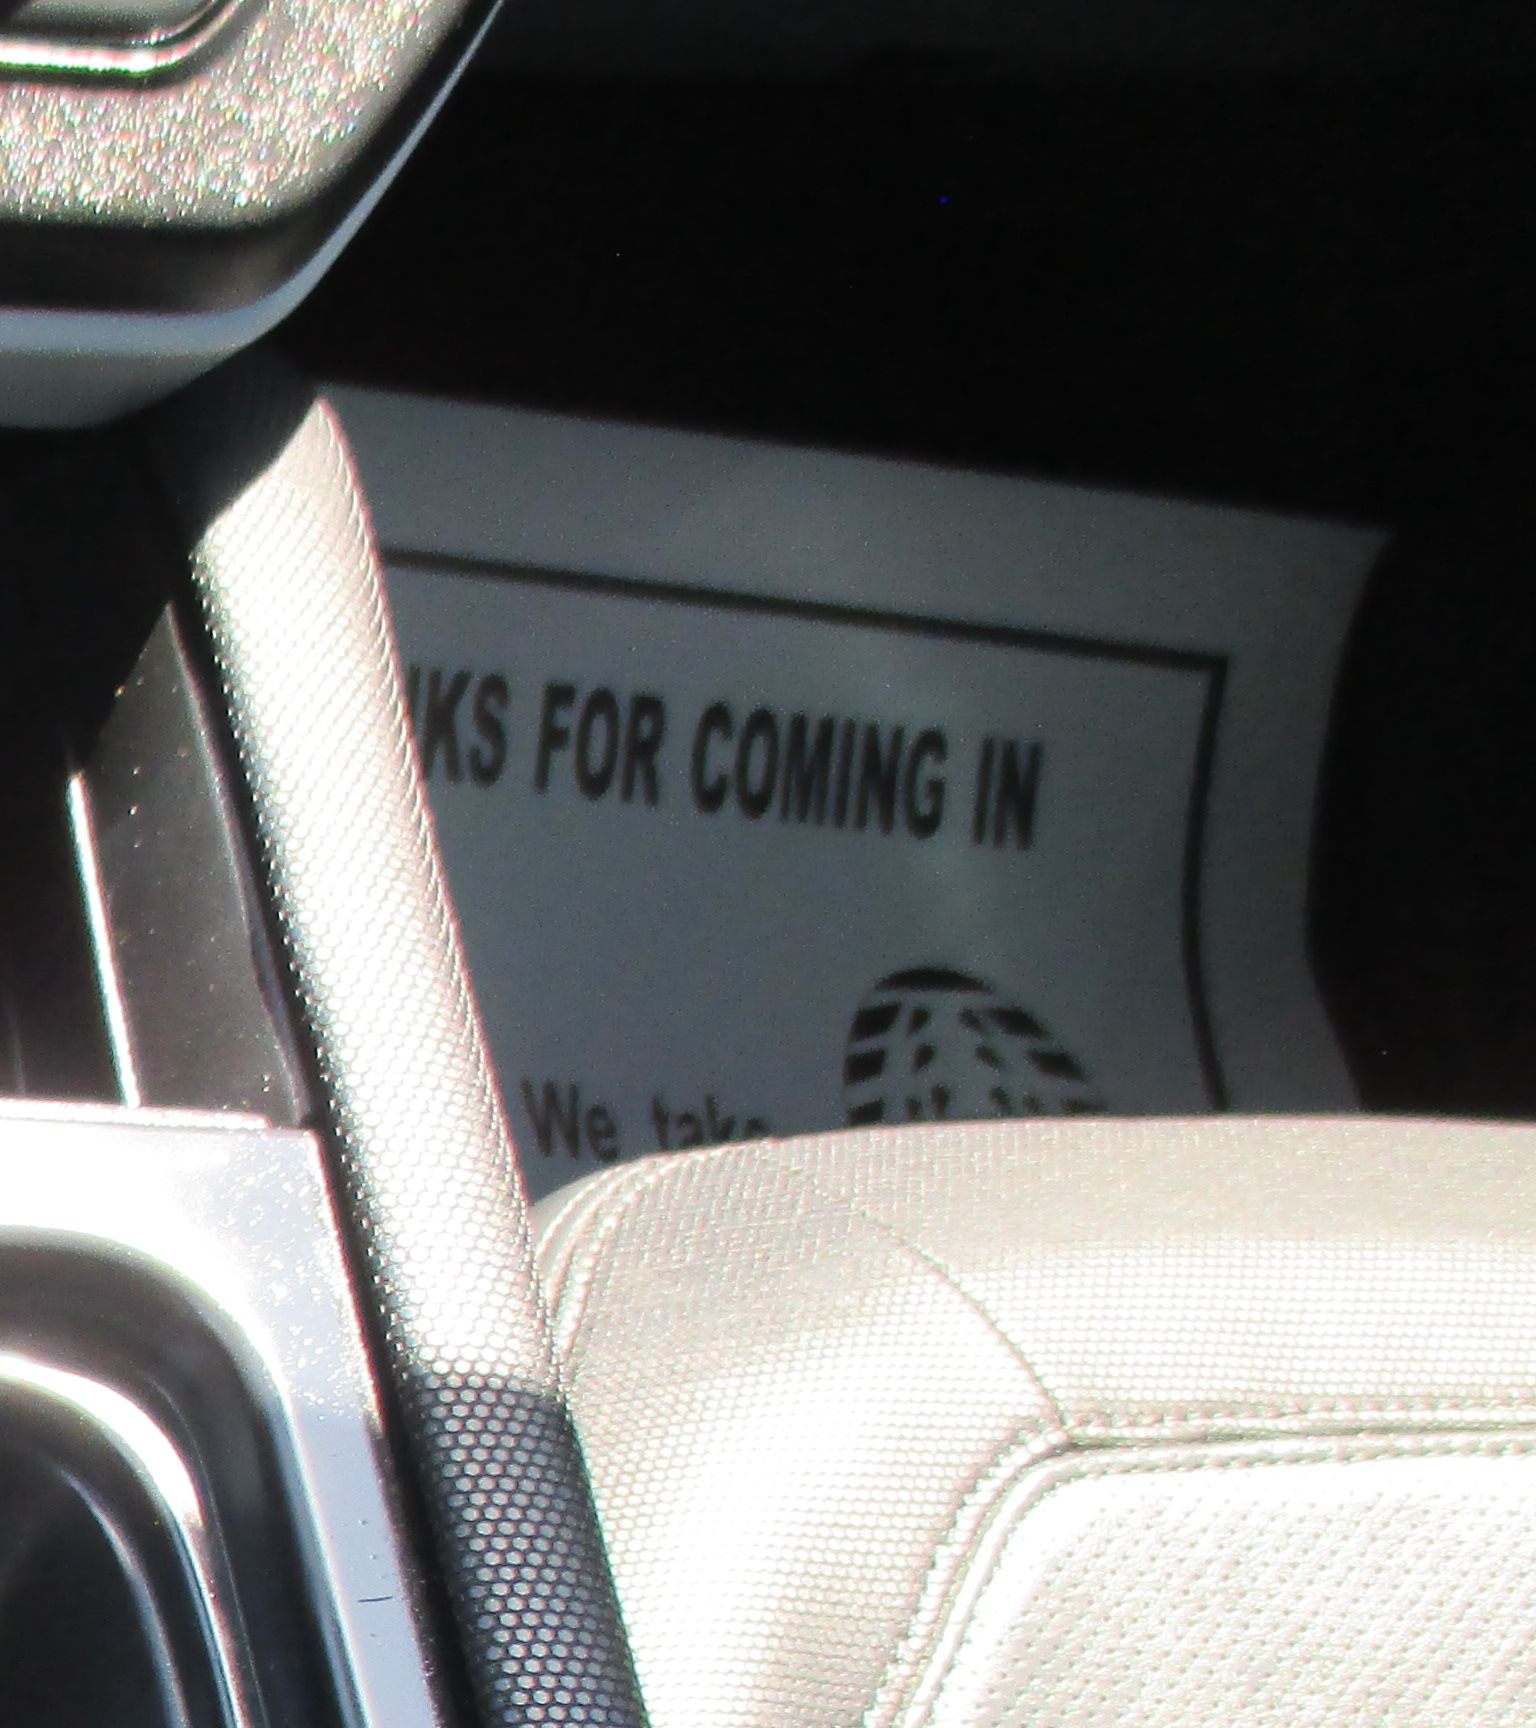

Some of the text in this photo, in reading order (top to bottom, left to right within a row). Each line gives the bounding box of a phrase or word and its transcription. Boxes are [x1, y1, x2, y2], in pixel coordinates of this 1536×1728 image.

[533, 680, 666, 808] FOR
[690, 698, 950, 840] COMING
[970, 734, 1045, 852] IN
[520, 1077, 620, 1163] We
